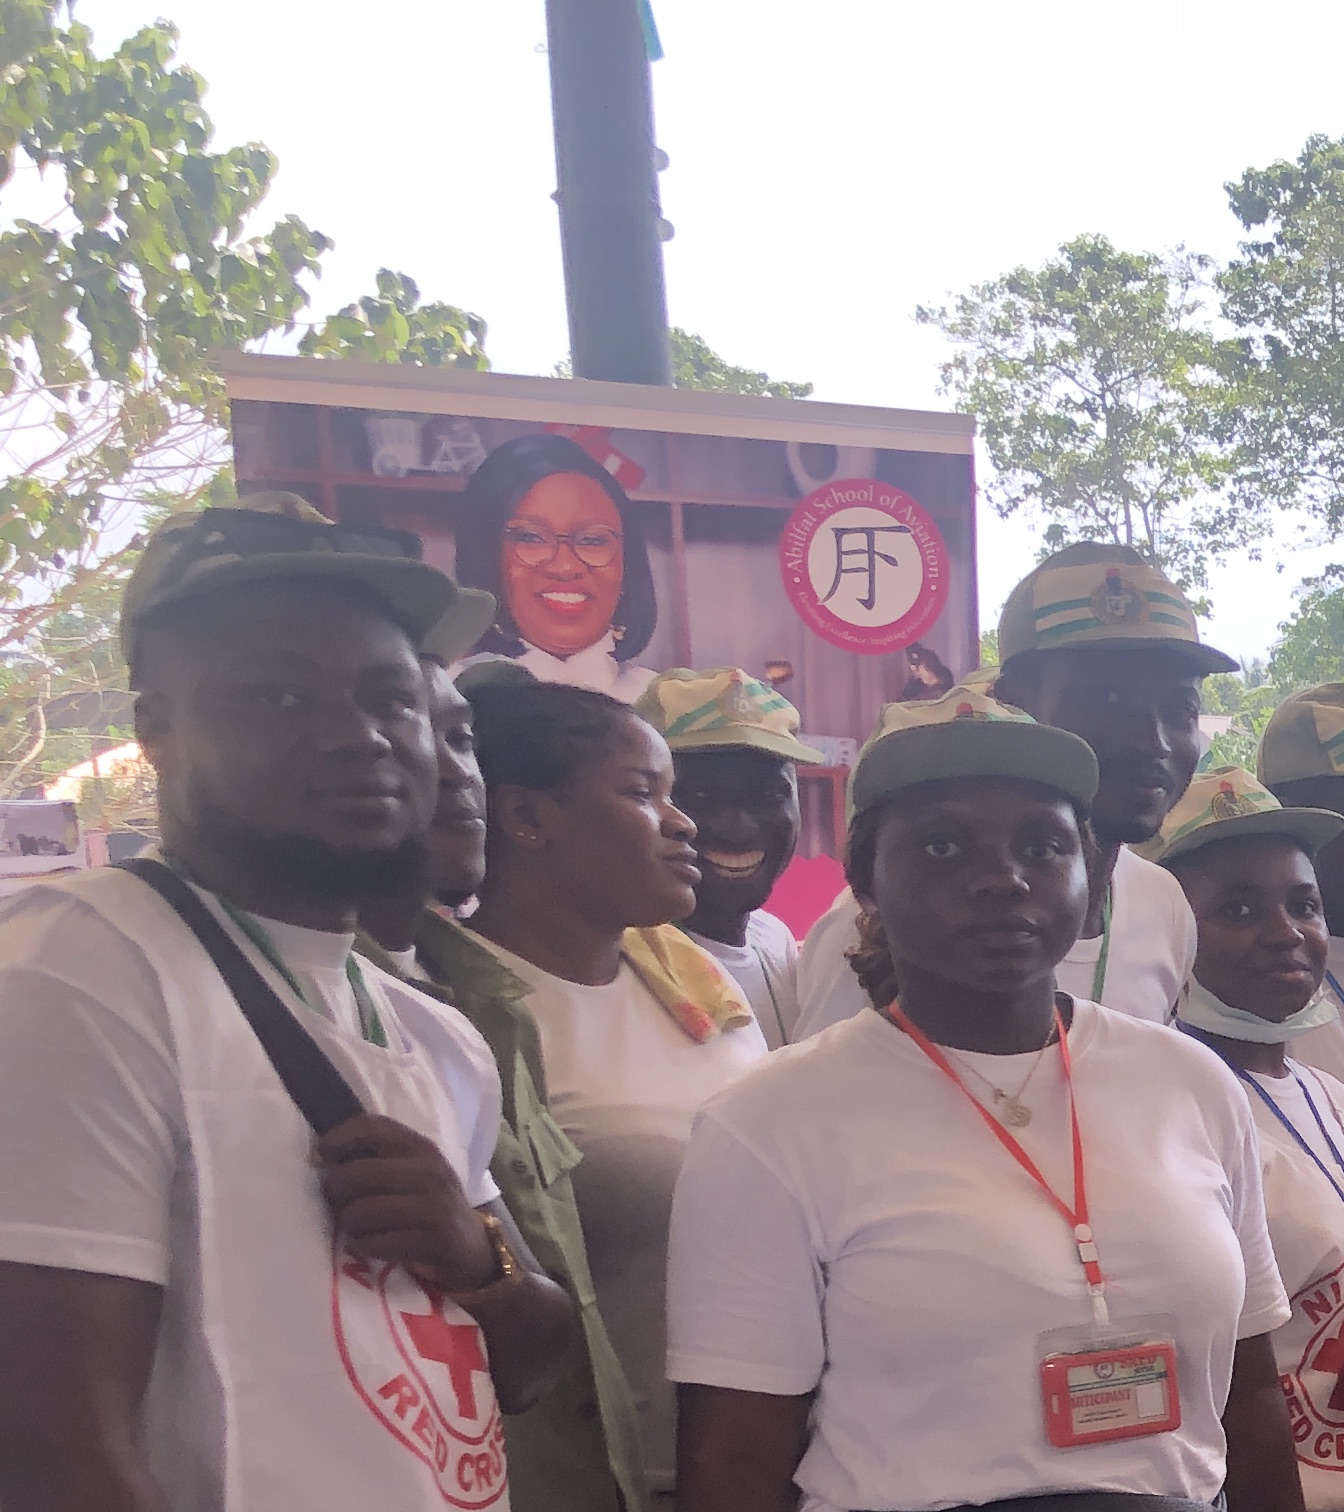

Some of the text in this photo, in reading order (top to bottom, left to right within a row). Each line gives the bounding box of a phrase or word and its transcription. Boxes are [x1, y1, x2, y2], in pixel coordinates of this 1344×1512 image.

[785, 511, 818, 573] Abilfat
[812, 485, 874, 515] School
[879, 494, 903, 509] of
[898, 505, 940, 579] Aviation
[377, 1373, 448, 1474] RED
